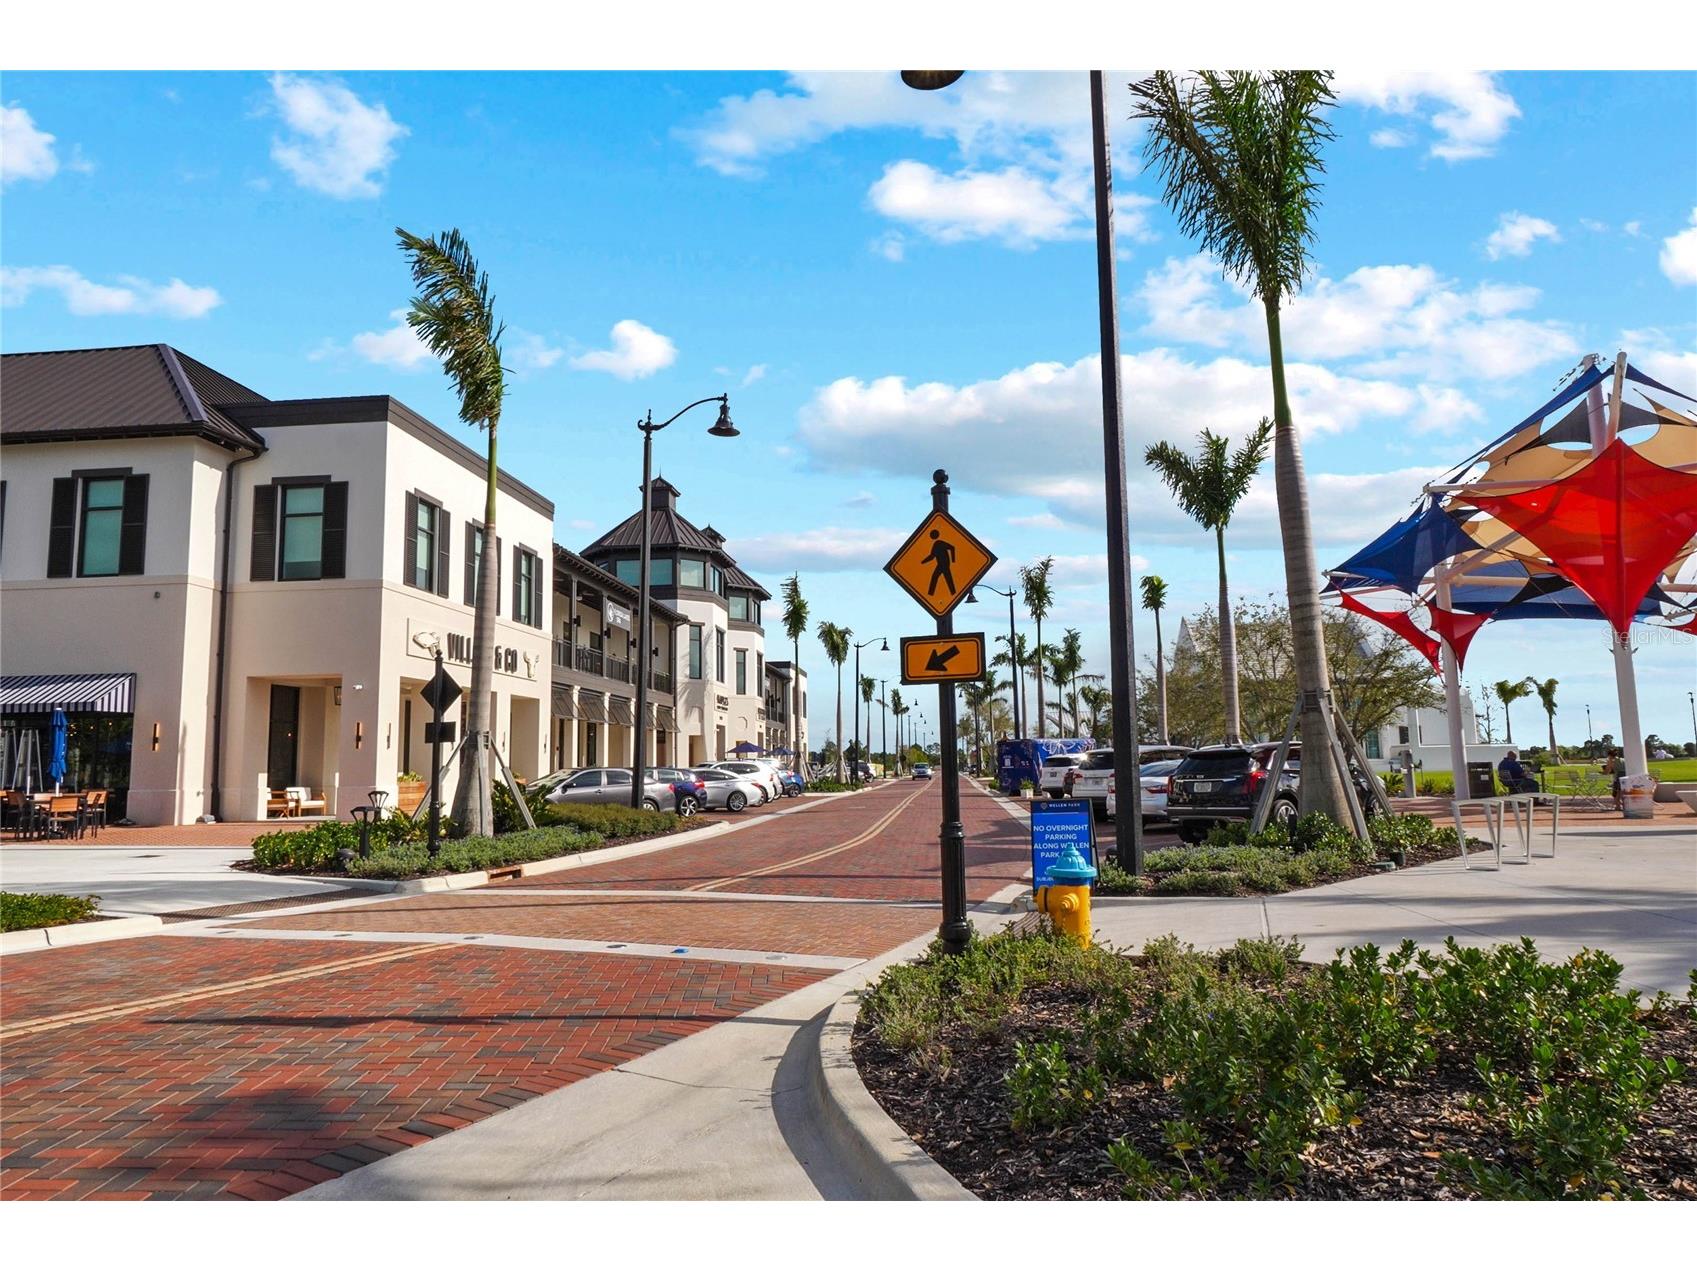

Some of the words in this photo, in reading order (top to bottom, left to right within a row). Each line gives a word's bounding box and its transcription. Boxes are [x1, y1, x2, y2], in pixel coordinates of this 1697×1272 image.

[494, 645, 502, 671] &
[504, 647, 518, 674] CO
[1046, 824, 1088, 832] OVERNIGHT
[1033, 842, 1059, 850] ALONG
